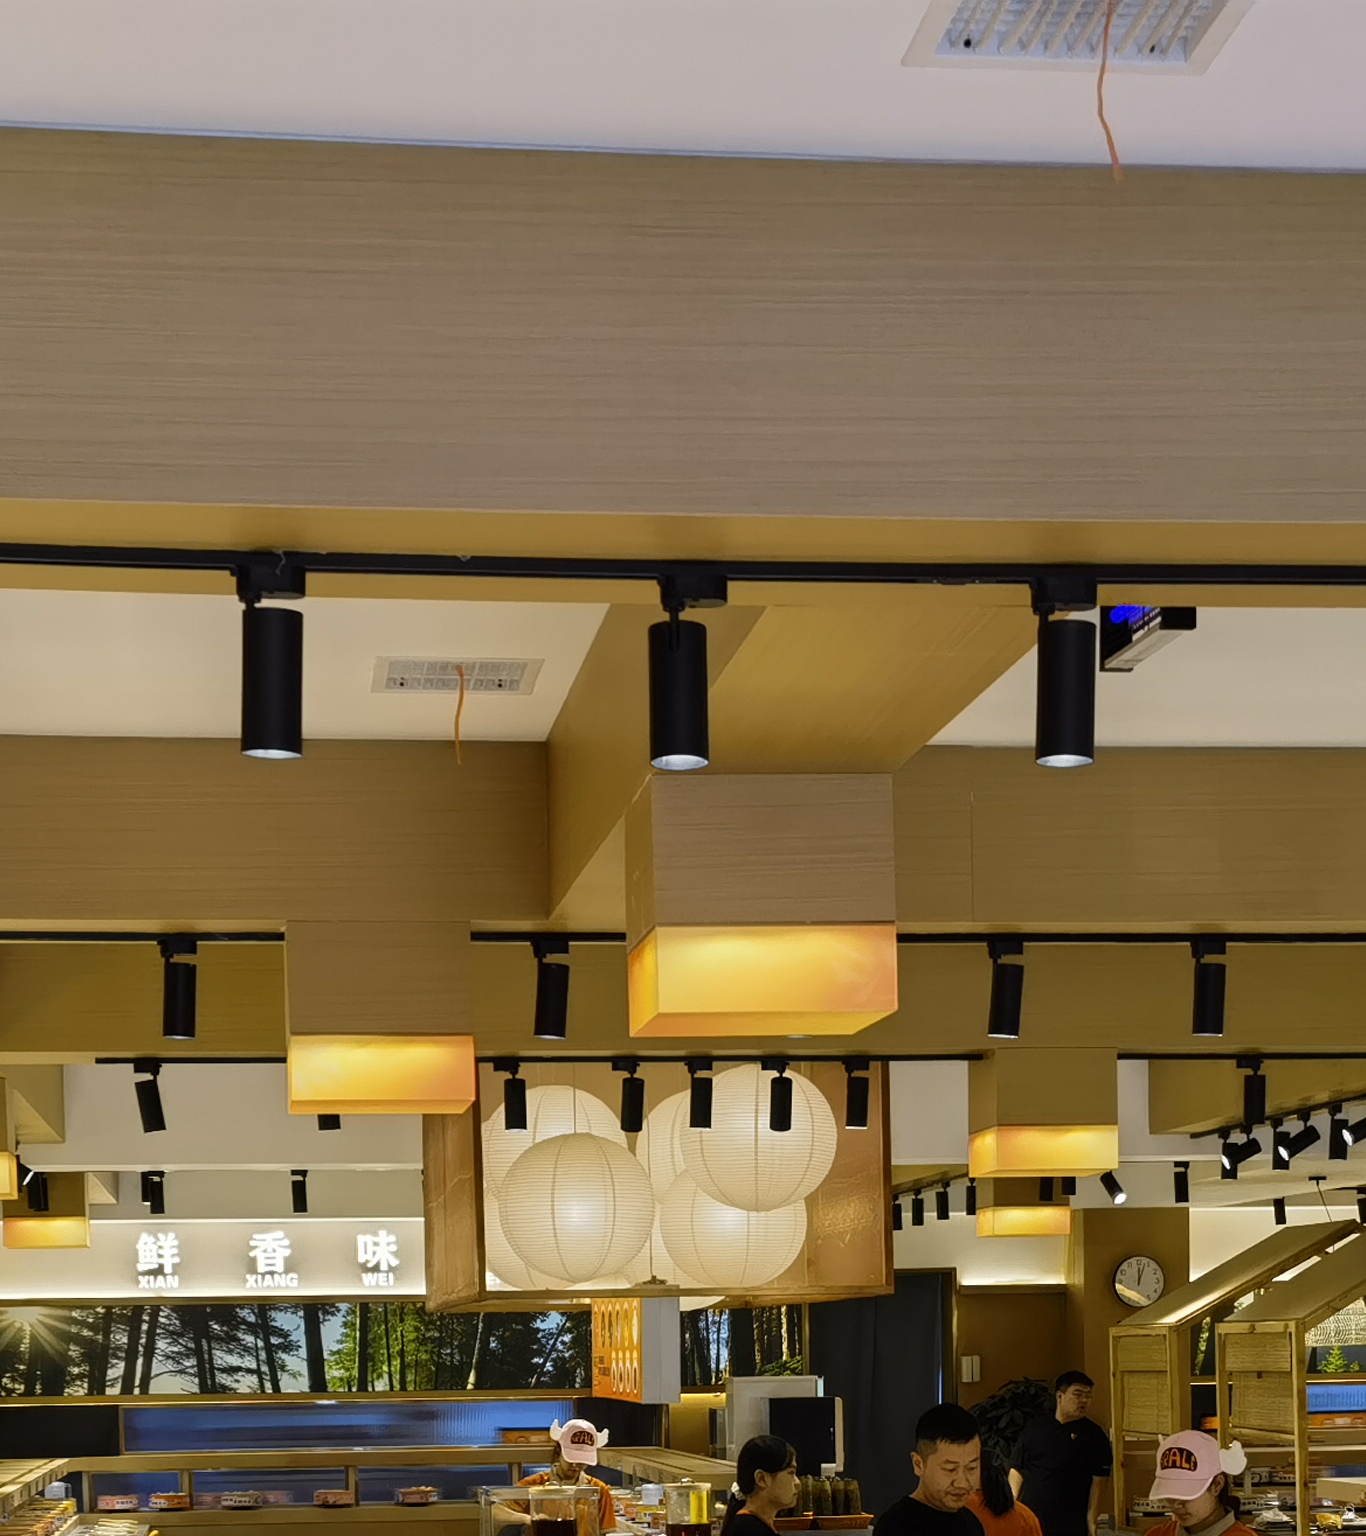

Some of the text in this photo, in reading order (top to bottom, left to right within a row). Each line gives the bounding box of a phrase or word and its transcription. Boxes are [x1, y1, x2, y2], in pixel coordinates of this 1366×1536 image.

[138, 1272, 394, 1289] XIAN XIANG WEI
